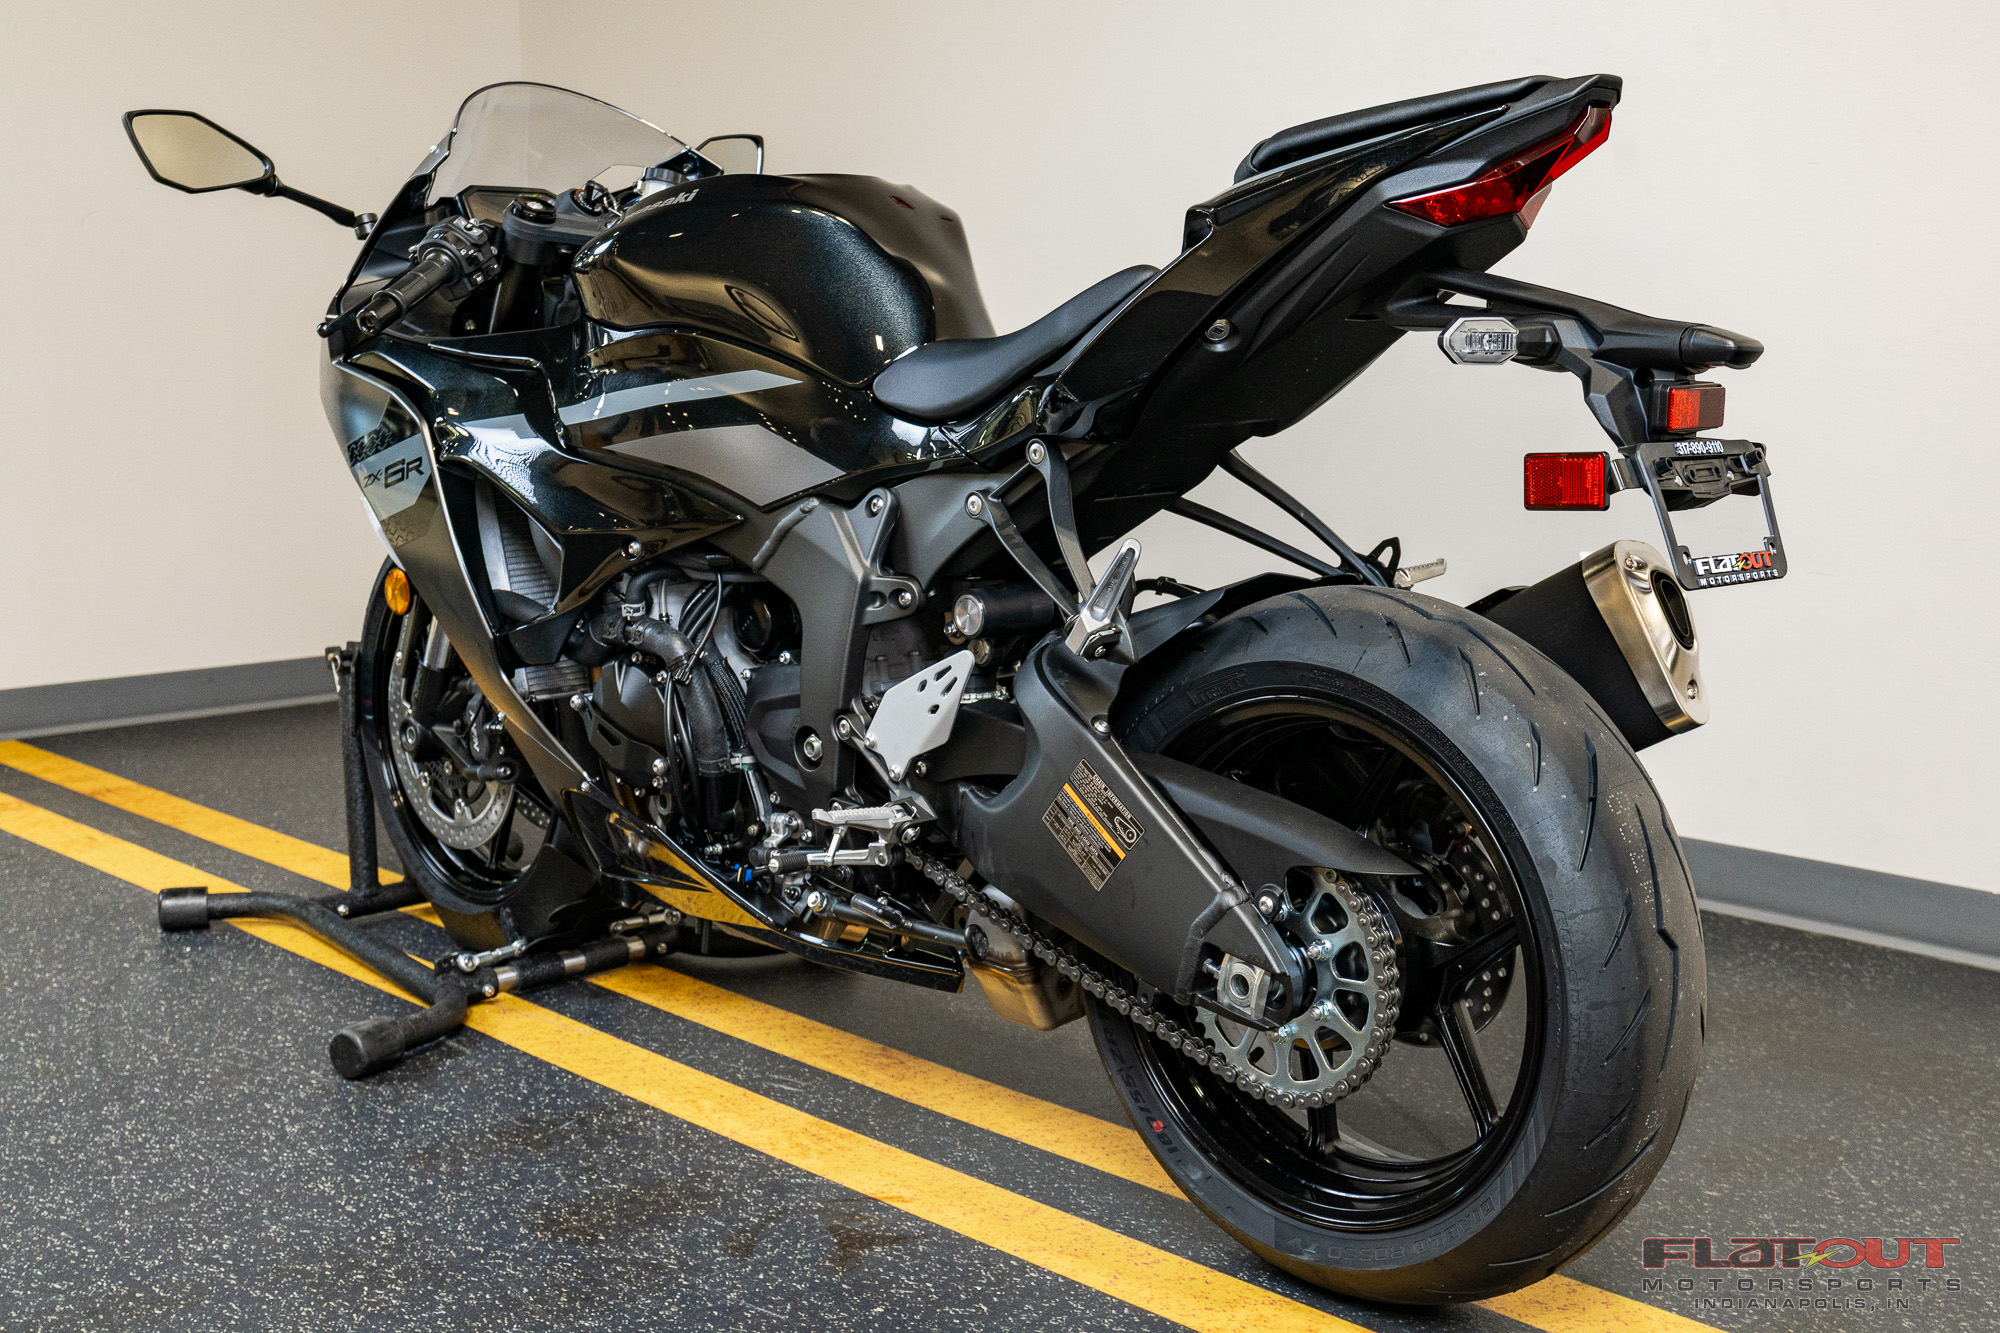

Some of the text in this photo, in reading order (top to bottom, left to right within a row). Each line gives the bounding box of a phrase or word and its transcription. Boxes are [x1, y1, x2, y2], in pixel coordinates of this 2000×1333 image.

[1676, 440, 1725, 455] 317-890-9110
[1698, 569, 1779, 586] MOTORSPORTS
[1105, 788, 1132, 820] INFORMATION
[1086, 811, 1104, 834] WARNING
